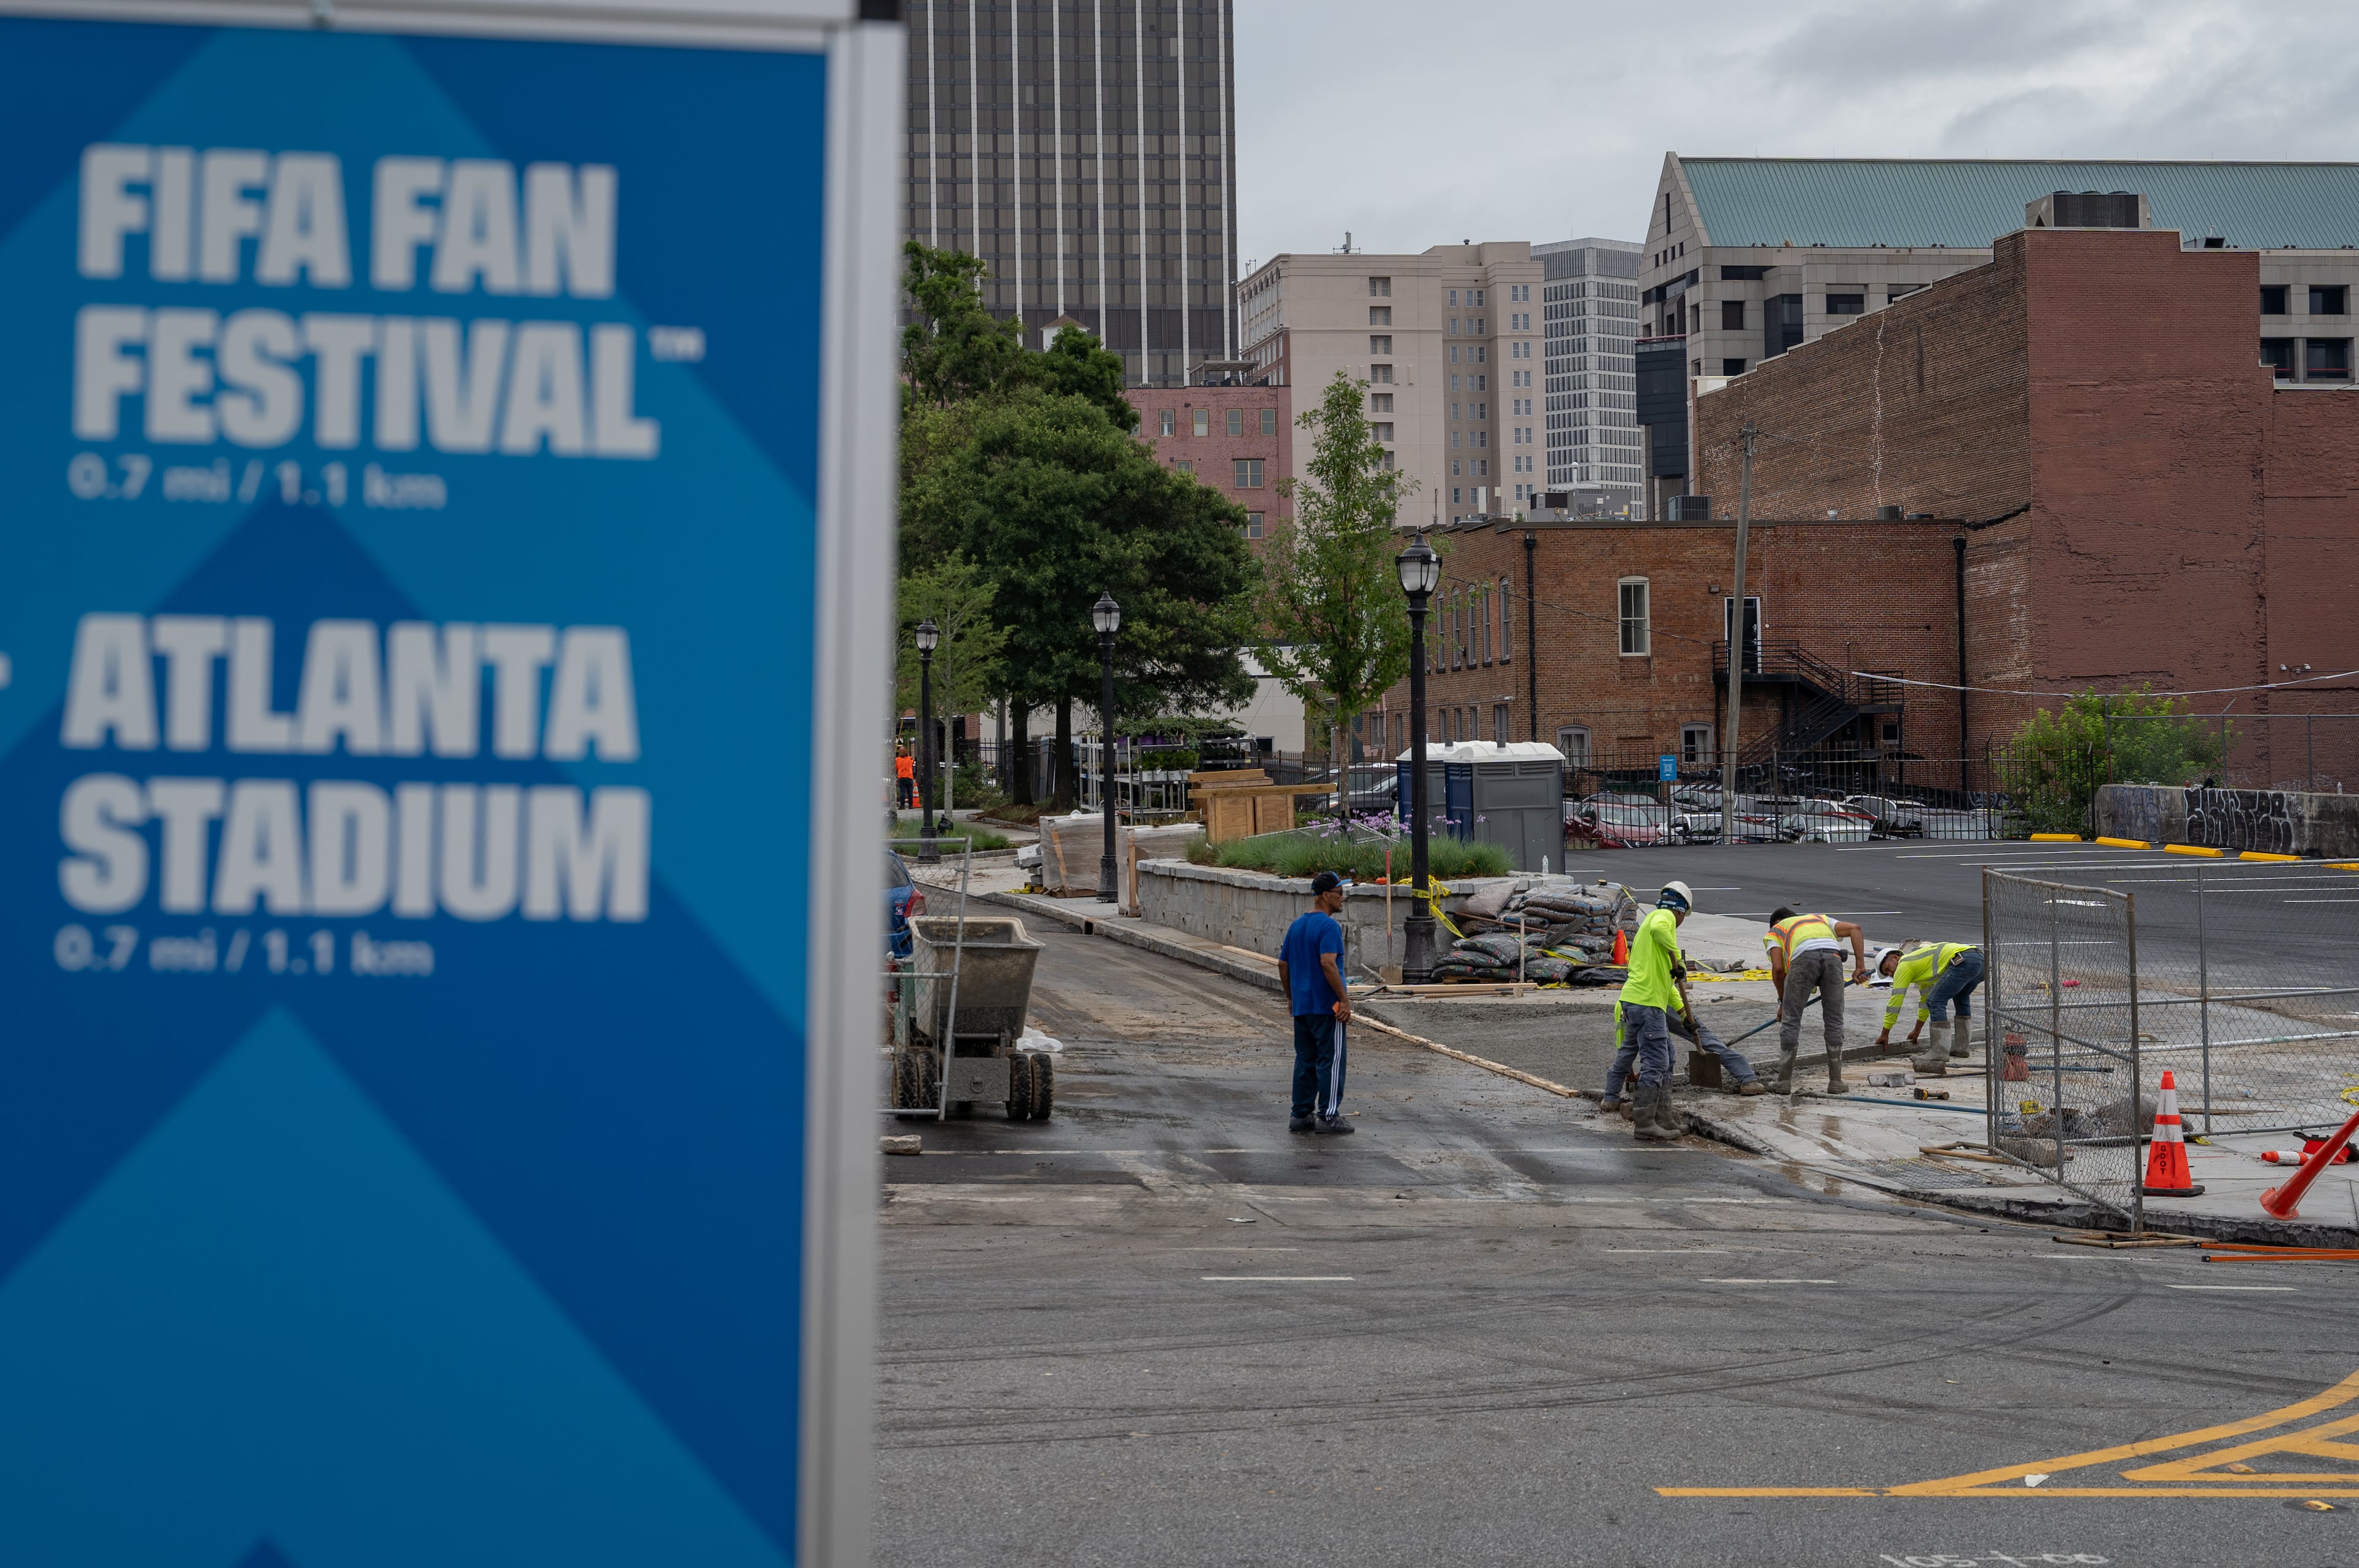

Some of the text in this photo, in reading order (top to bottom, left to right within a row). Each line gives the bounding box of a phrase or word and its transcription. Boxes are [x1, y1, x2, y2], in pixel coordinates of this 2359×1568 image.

[77, 144, 617, 299] FIFA FAN
[67, 452, 447, 511] 0.7 mi / 1.1 km
[61, 612, 640, 763] ATLANTA
[58, 773, 651, 922] STADIUM
[53, 924, 435, 977] 0.7 mi / 1.1 km
